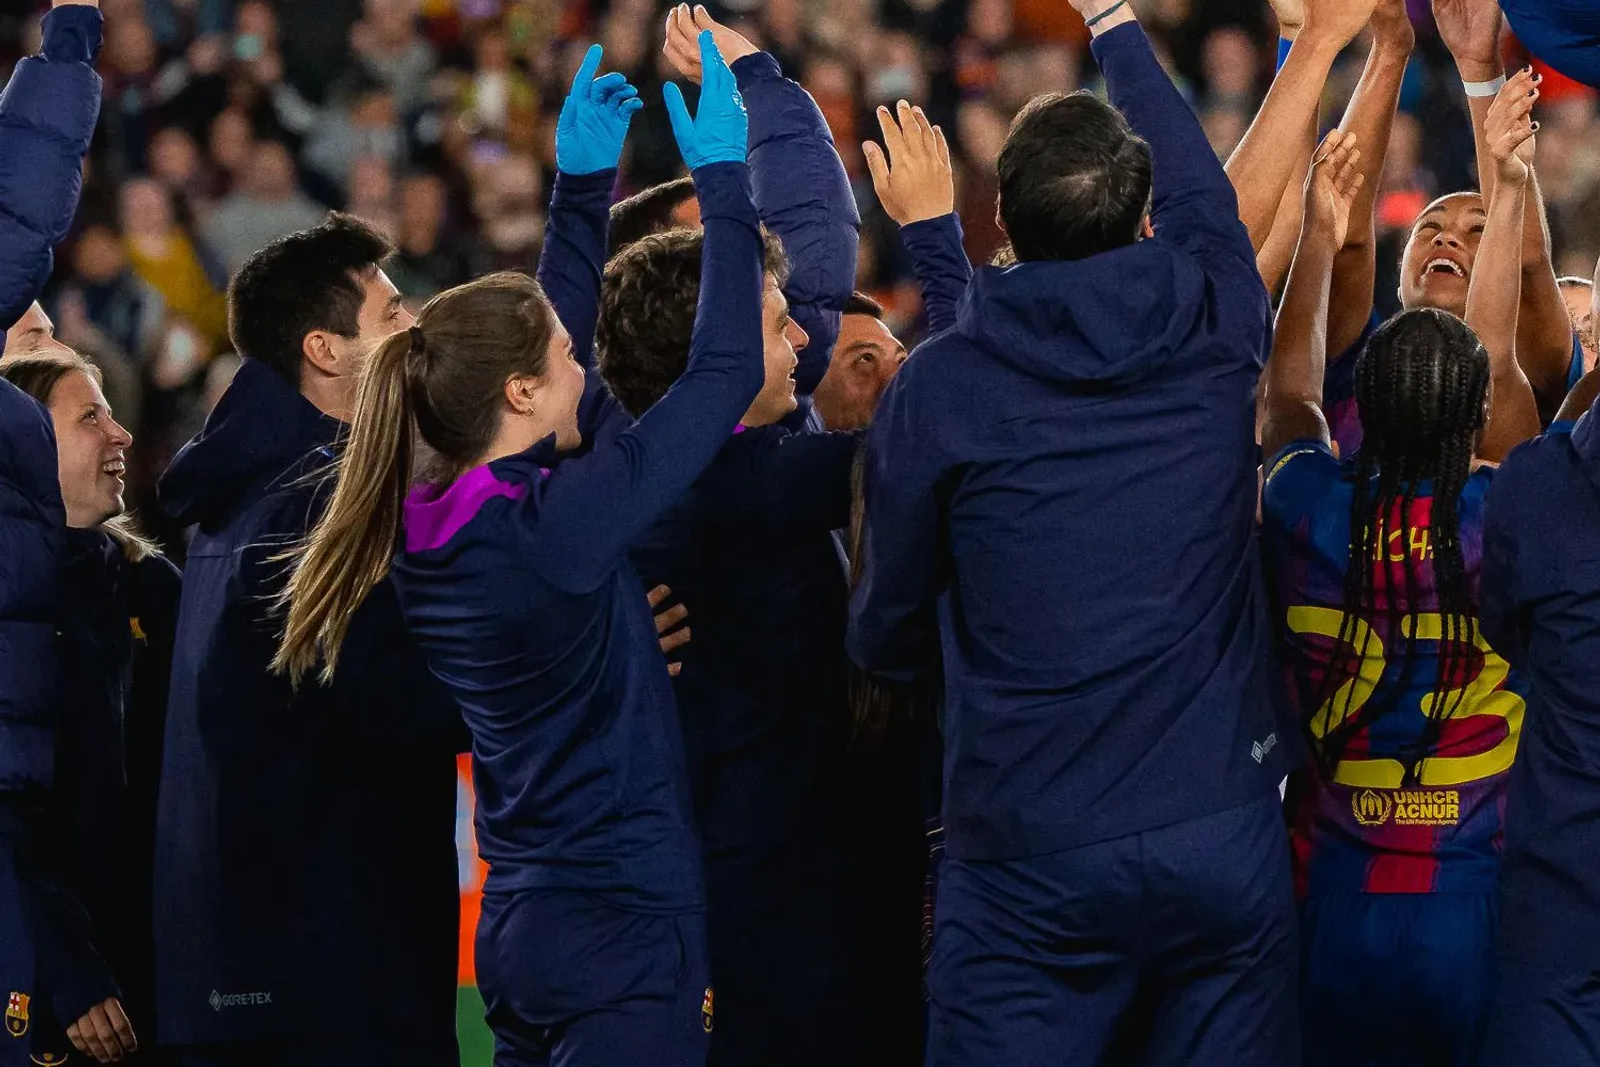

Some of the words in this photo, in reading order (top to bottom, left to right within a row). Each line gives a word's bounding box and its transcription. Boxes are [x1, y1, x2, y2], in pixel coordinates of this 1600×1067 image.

[1286, 605, 1527, 790] 23
[1393, 791, 1459, 804] UNHCR
[1394, 804, 1459, 819] ACNUR
